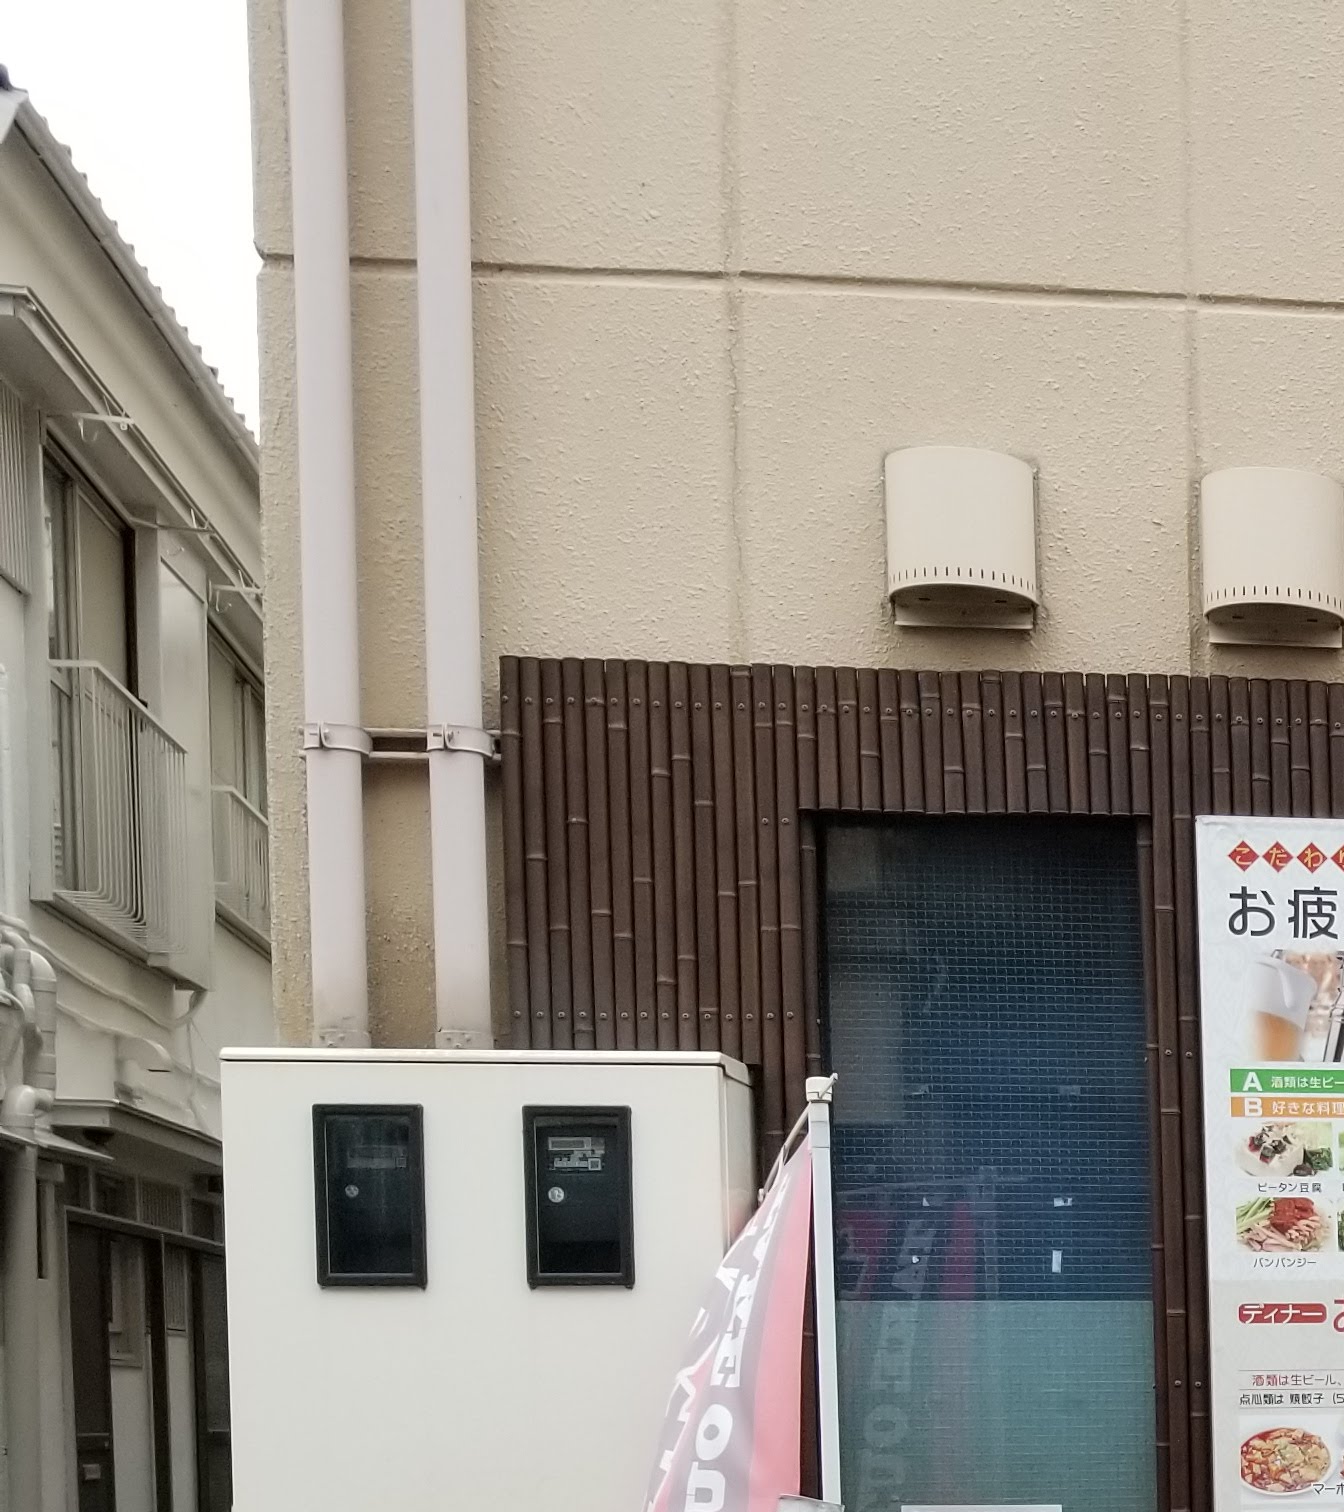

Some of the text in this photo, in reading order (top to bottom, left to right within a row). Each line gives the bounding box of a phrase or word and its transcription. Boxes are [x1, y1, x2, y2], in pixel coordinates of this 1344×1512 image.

[1243, 1071, 1262, 1091] A
[1244, 1097, 1262, 1116] B
[1242, 1304, 1323, 1324] ディナー
